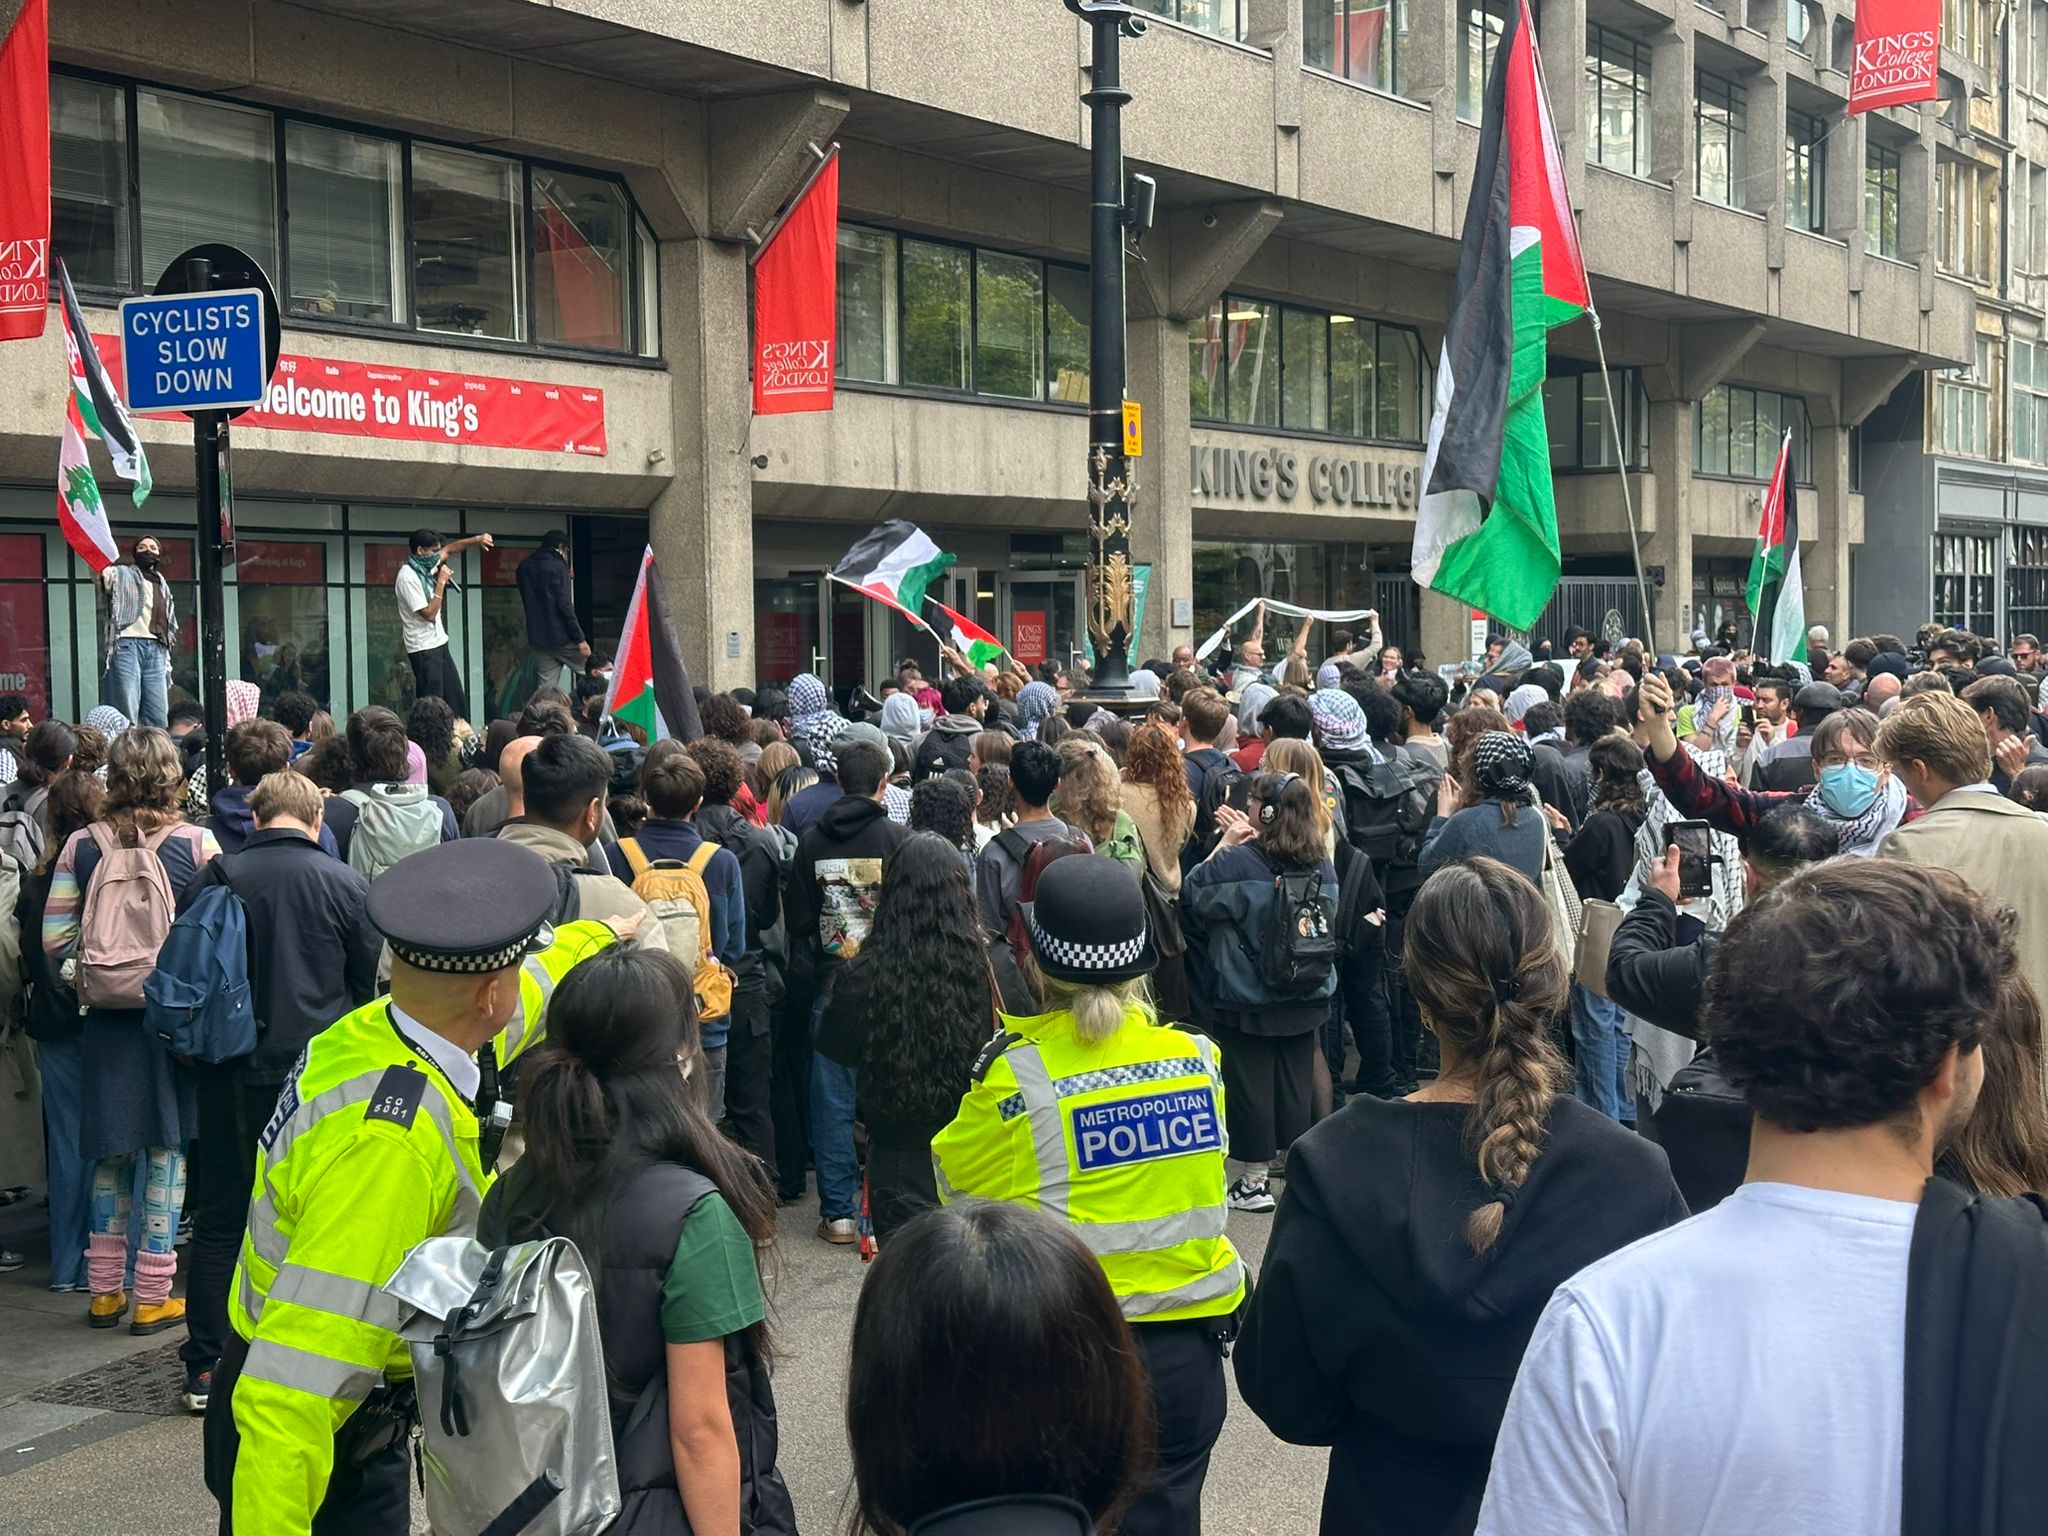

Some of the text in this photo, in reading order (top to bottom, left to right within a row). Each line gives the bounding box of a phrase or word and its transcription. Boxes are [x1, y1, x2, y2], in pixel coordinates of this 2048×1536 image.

[1854, 31, 1935, 75] KING'S
[1876, 50, 1933, 68] College
[1853, 64, 1932, 93] LONDON
[132, 304, 250, 336] CYCLISTS
[158, 336, 228, 364] SLOW
[156, 367, 233, 394] DOWN
[372, 388, 401, 424] to
[408, 389, 479, 437] King's
[1190, 446, 1299, 500] KING'S
[385, 1095, 403, 1106] CO
[1079, 1093, 1209, 1128] METROPOLITAN
[1082, 1112, 1216, 1162] POLICE
